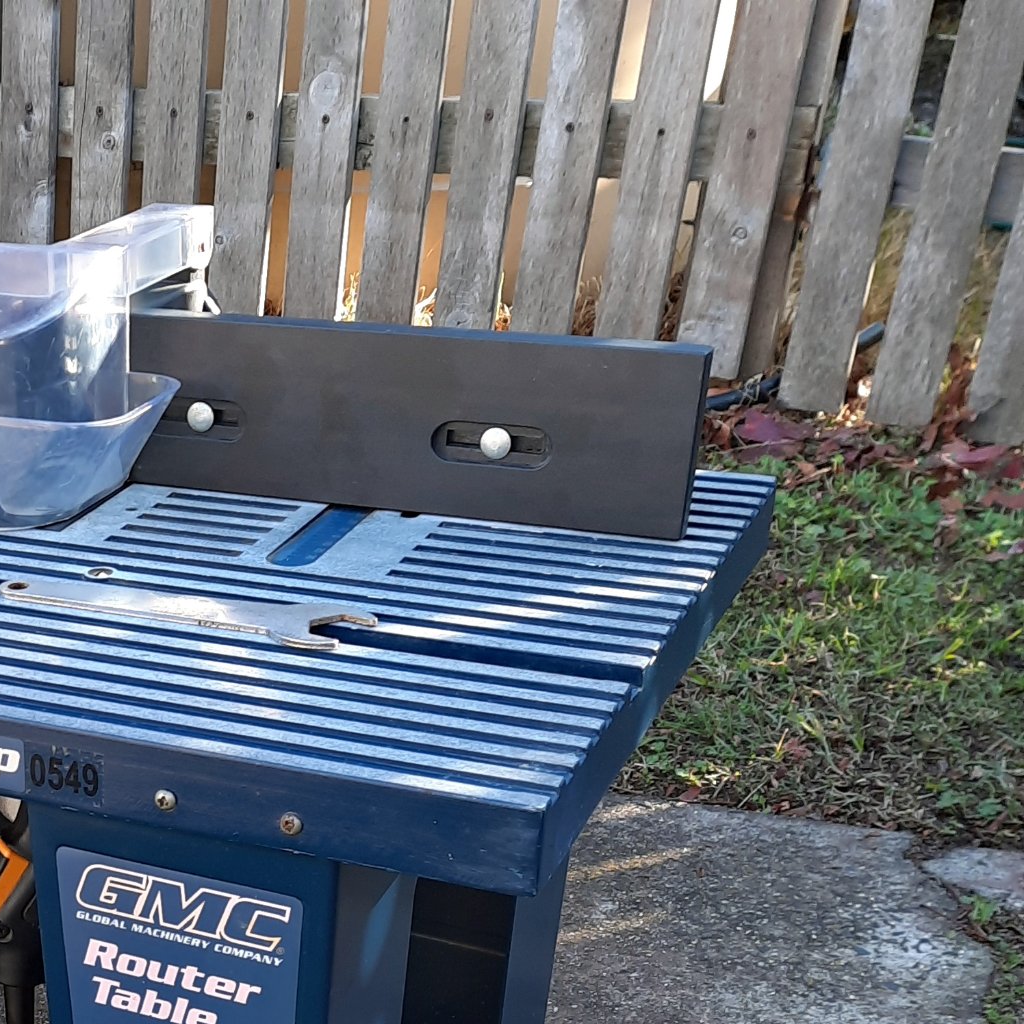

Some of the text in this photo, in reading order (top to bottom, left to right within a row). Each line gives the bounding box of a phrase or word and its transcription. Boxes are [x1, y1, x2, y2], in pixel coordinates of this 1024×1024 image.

[30, 754, 98, 796] 0549
[76, 863, 291, 951] GMC
[76, 911, 283, 966] GLOBAL MACHINERY COMPANY
[83, 938, 261, 1004] Router
